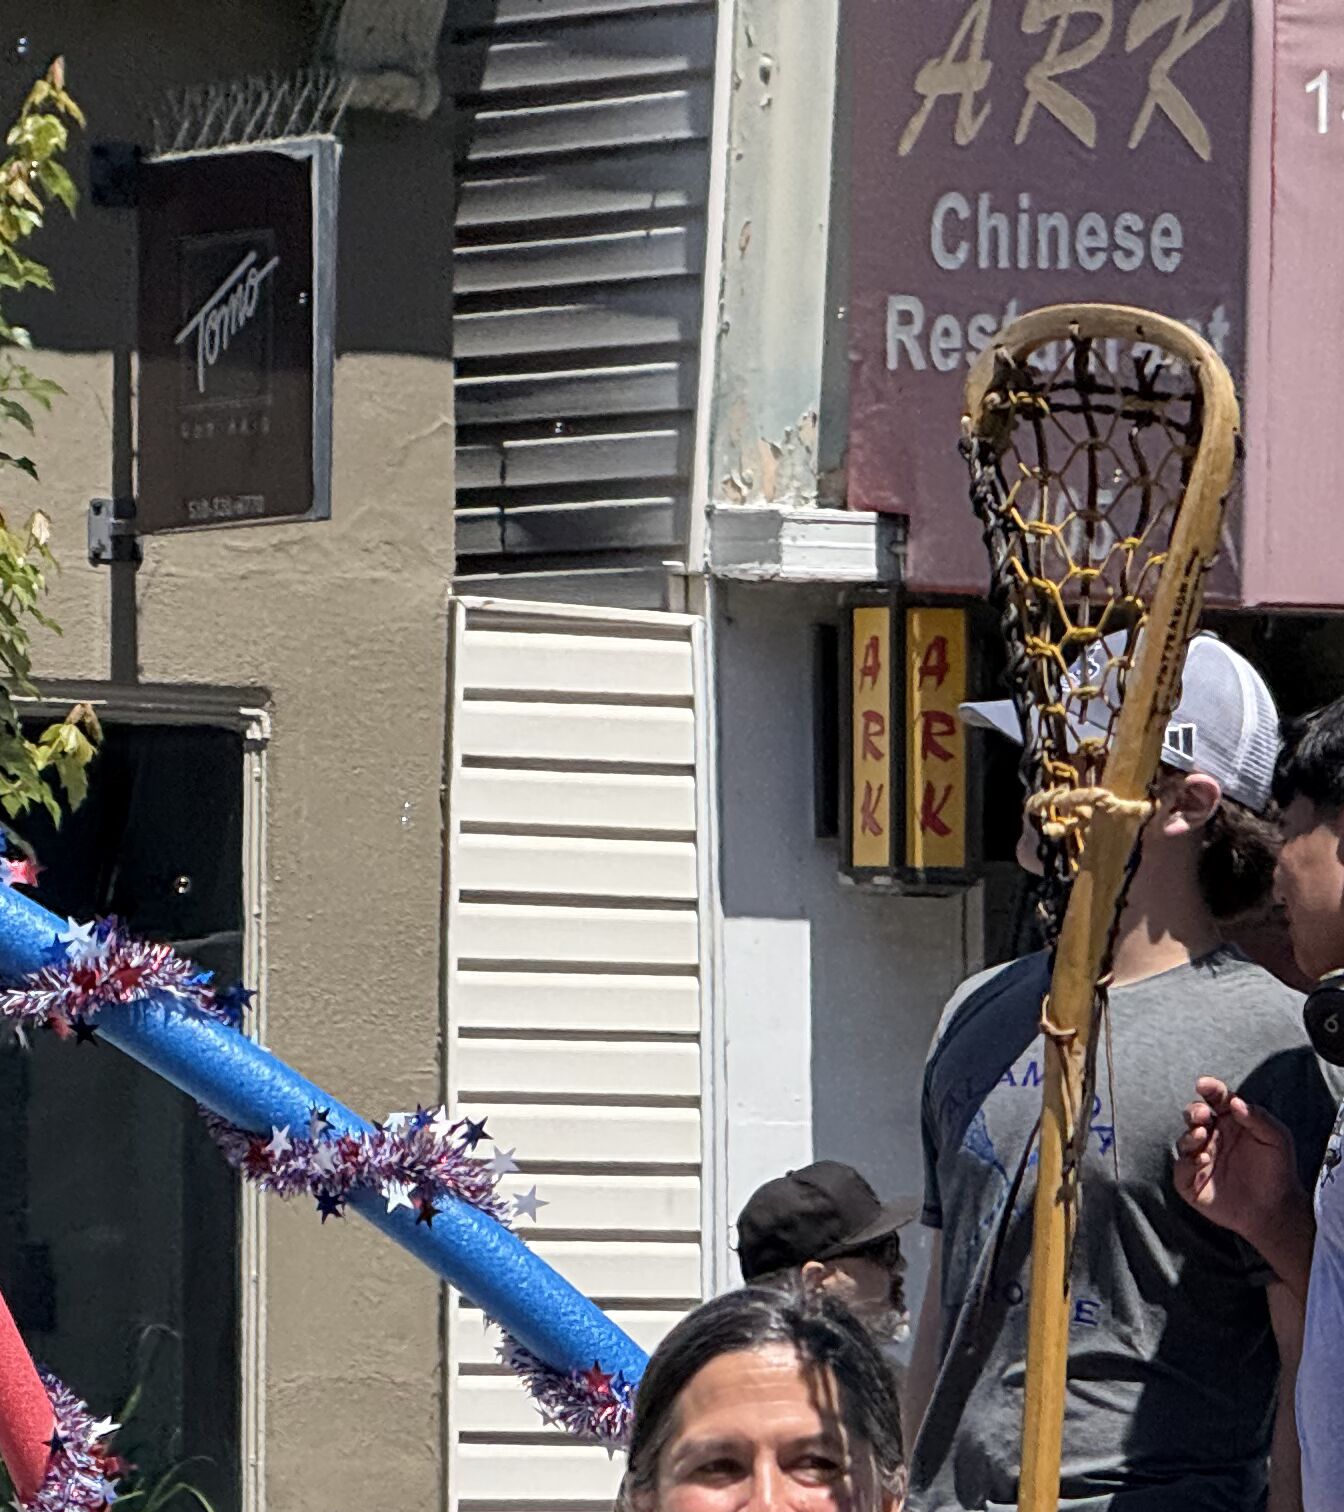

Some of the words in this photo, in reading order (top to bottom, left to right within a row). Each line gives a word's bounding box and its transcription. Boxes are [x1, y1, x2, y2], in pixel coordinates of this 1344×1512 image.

[899, 0, 1226, 161] ARK
[930, 191, 1184, 273] Chinese
[859, 635, 885, 837] ARK
[918, 635, 956, 837] ARK
